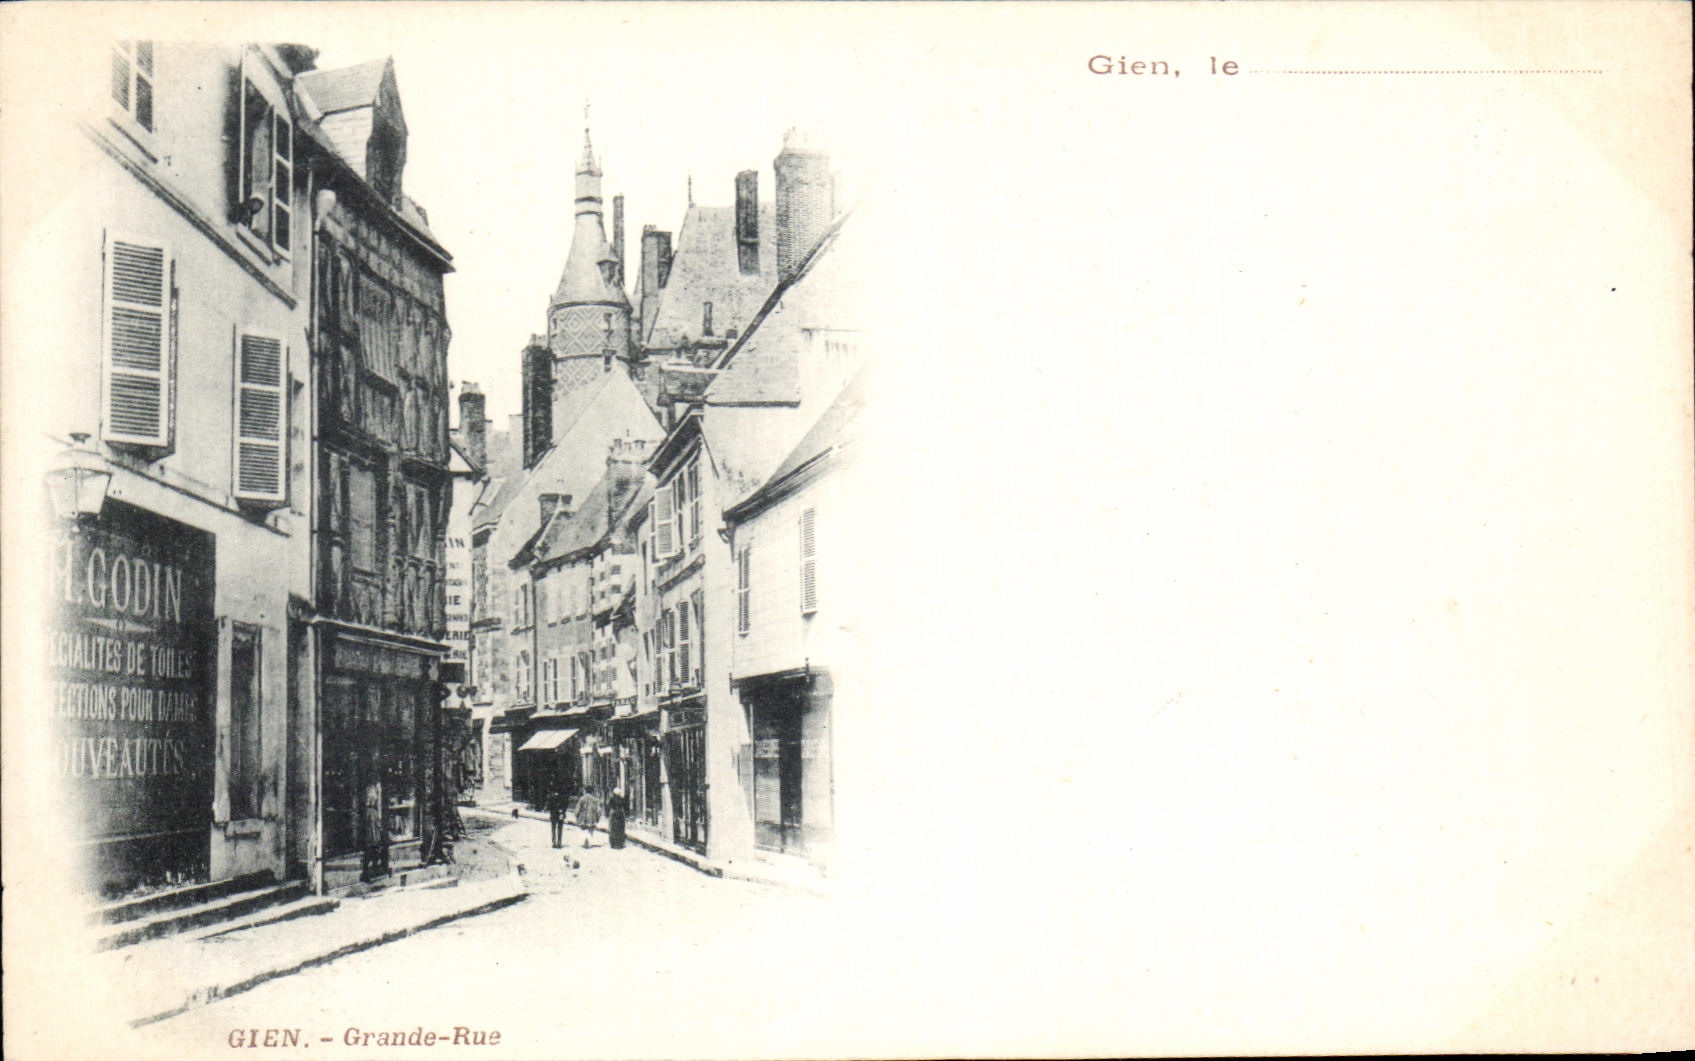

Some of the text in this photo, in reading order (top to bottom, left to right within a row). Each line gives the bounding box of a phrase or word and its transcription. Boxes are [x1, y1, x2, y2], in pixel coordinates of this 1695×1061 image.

[87, 547, 183, 624] GODIN
[46, 631, 193, 679] ECIALITES DE TOILES
[48, 681, 117, 721] FECTIONS
[121, 685, 154, 722] POUR
